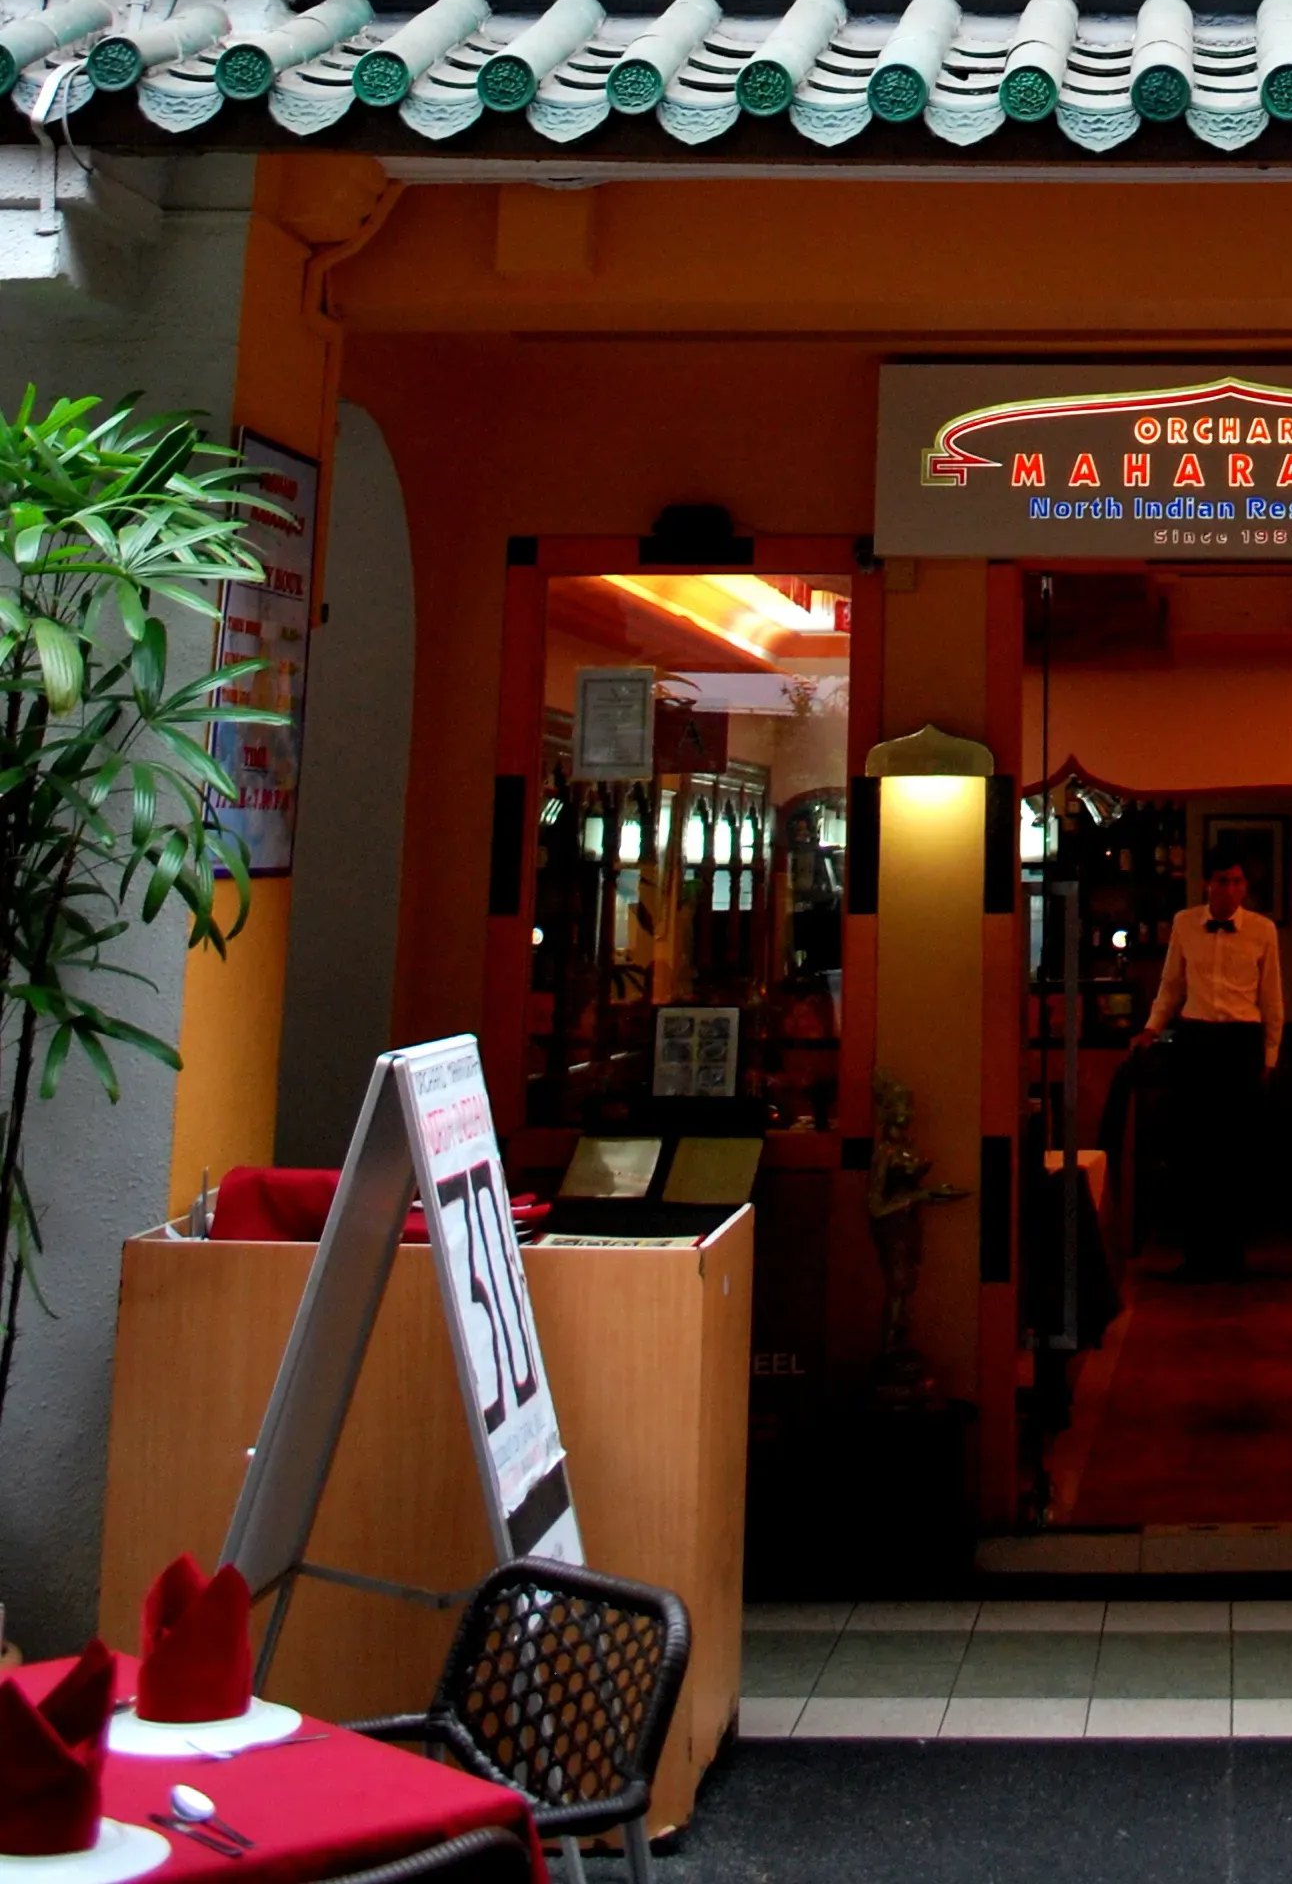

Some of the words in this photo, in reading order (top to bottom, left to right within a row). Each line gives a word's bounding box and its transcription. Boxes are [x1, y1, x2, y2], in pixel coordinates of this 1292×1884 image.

[1028, 496, 1124, 521] North
[1133, 496, 1235, 521] Indian
[1153, 528, 1229, 546] Since
[750, 1352, 805, 1376] EEL
